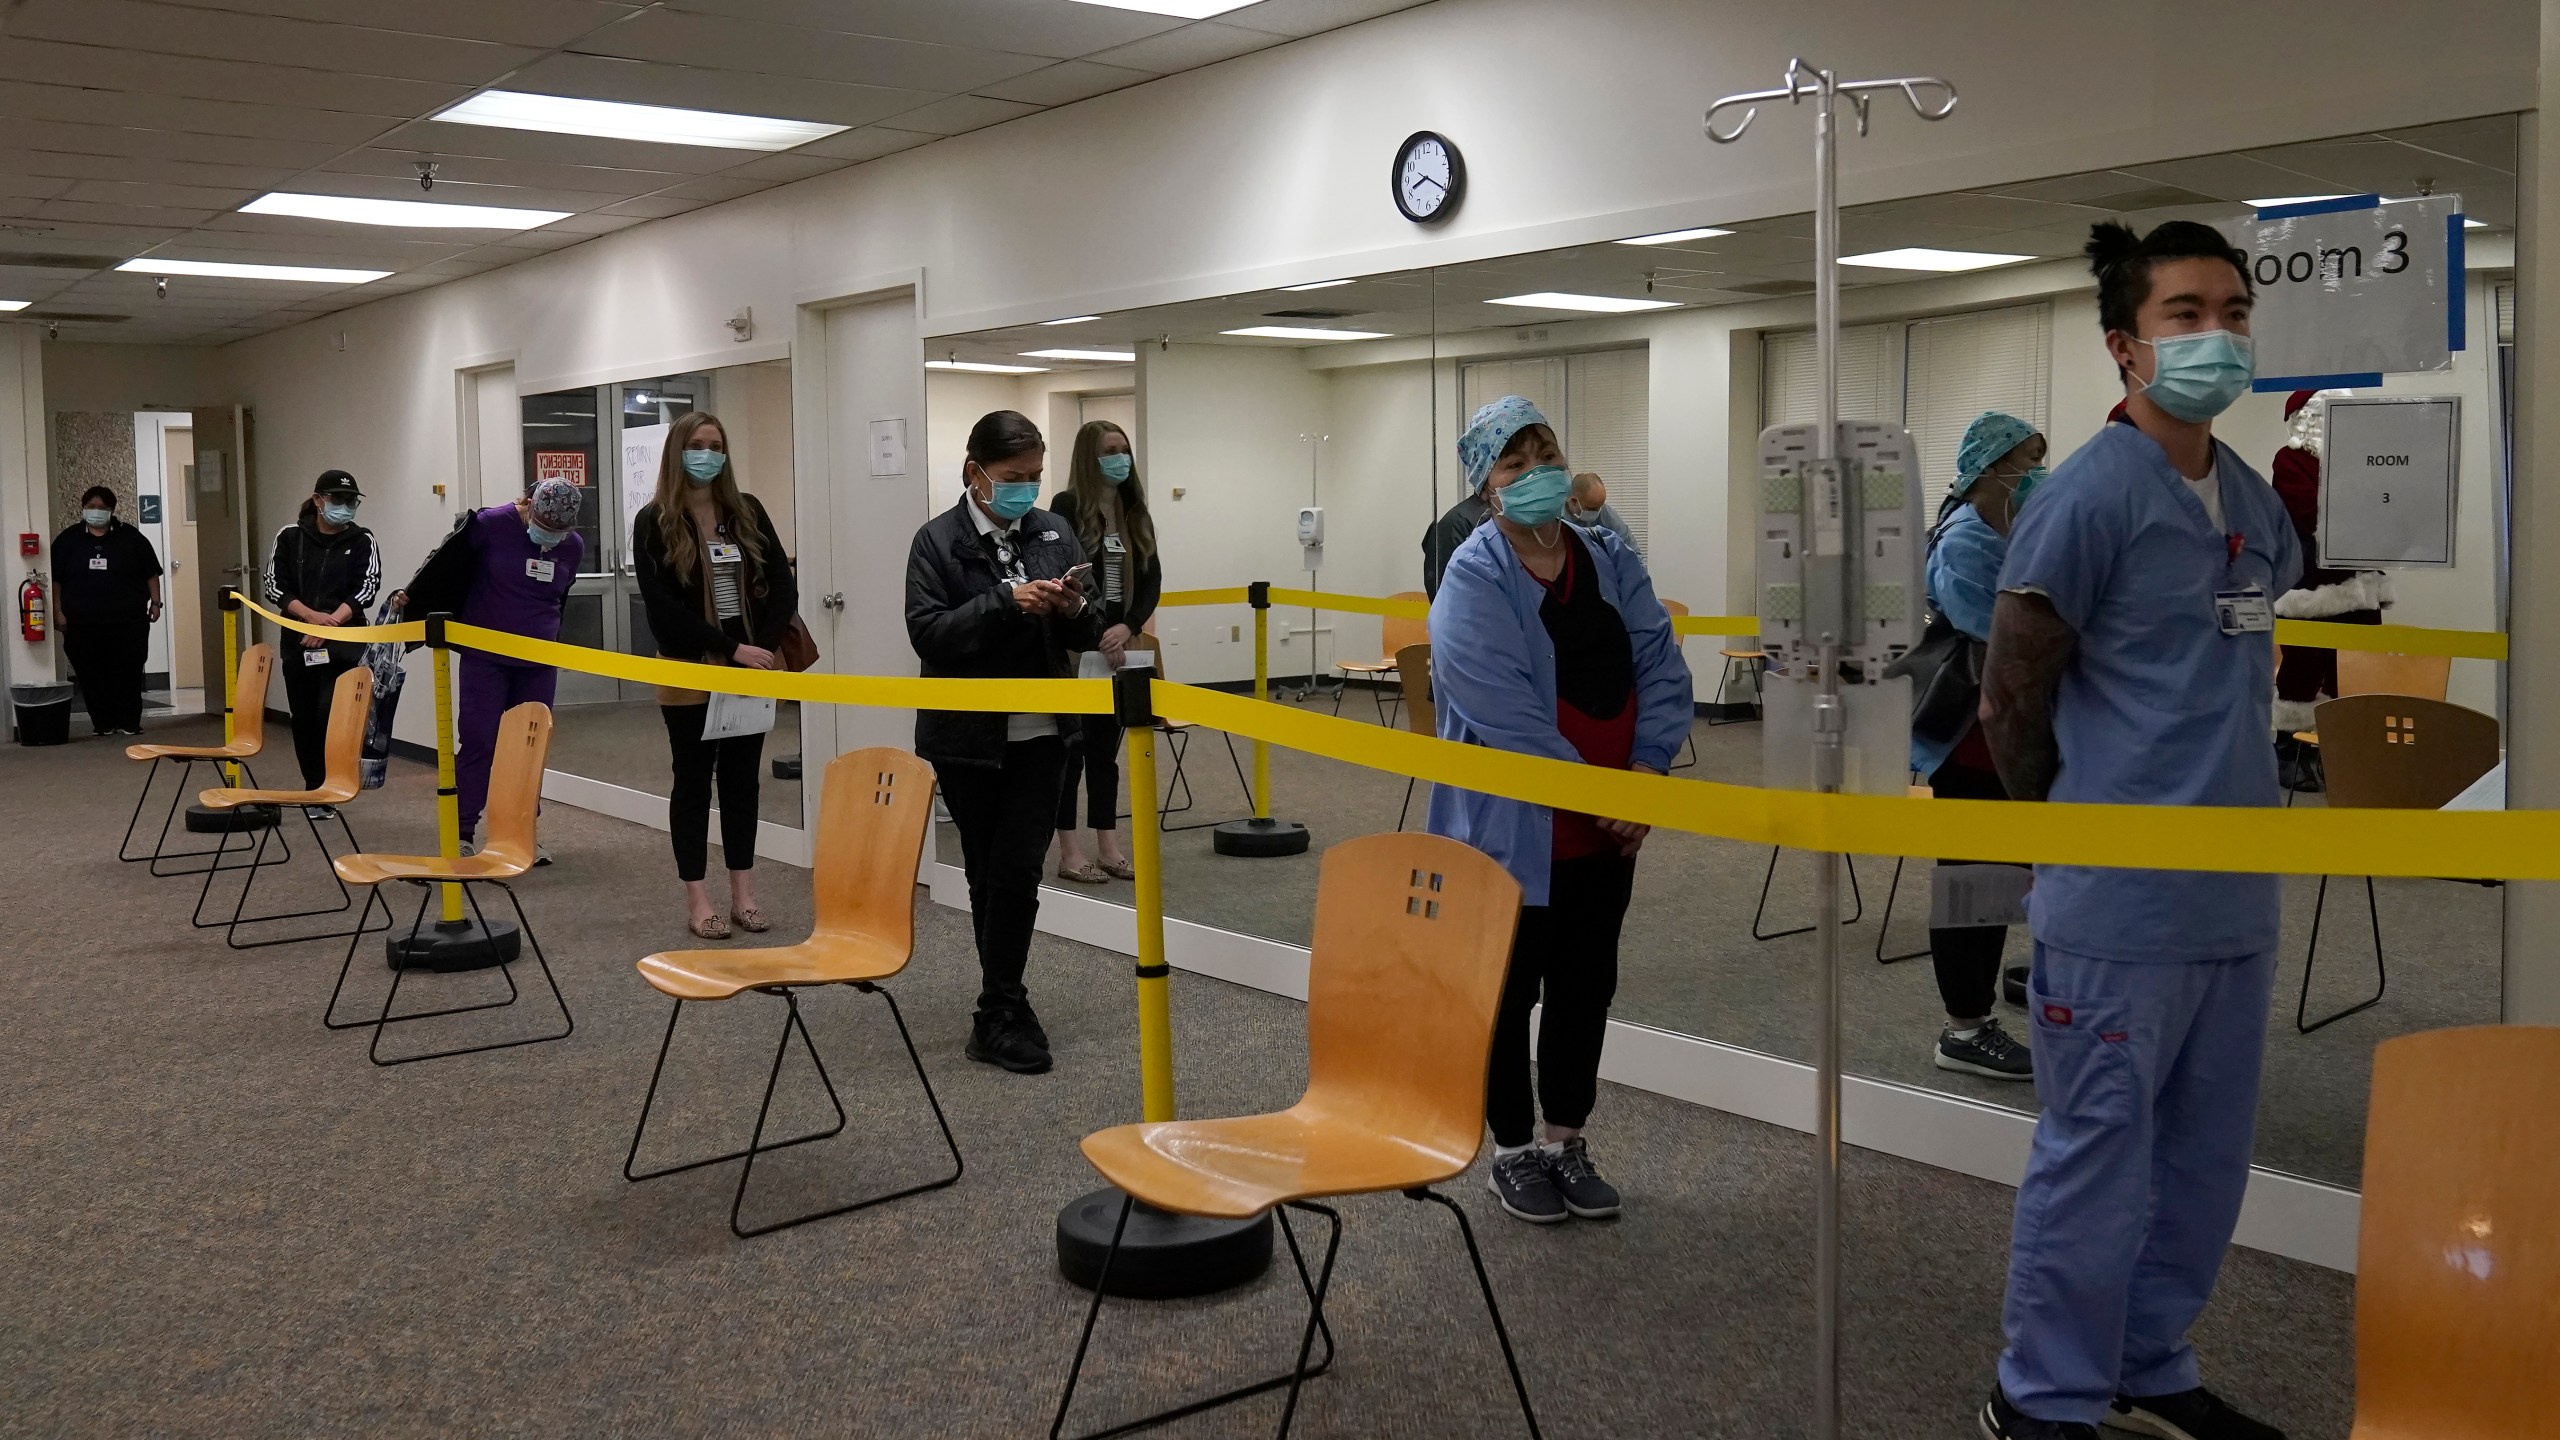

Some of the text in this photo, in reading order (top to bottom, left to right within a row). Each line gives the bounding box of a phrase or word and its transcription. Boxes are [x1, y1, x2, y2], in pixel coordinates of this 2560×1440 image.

[1422, 142, 1431, 155] 12
[1414, 149, 1421, 160] 11
[1441, 155, 1447, 166] 2
[1407, 160, 1415, 173] 10
[1404, 176, 1410, 187] 9
[1408, 188, 1414, 200] 8
[1416, 199, 1421, 210] 7
[1425, 201, 1432, 211] 6
[1435, 195, 1441, 207] 5
[2382, 230, 2410, 274] 3
[625, 444, 652, 467] RETURN
[2366, 455, 2409, 466] ROOM
[2382, 492, 2390, 503] 3
